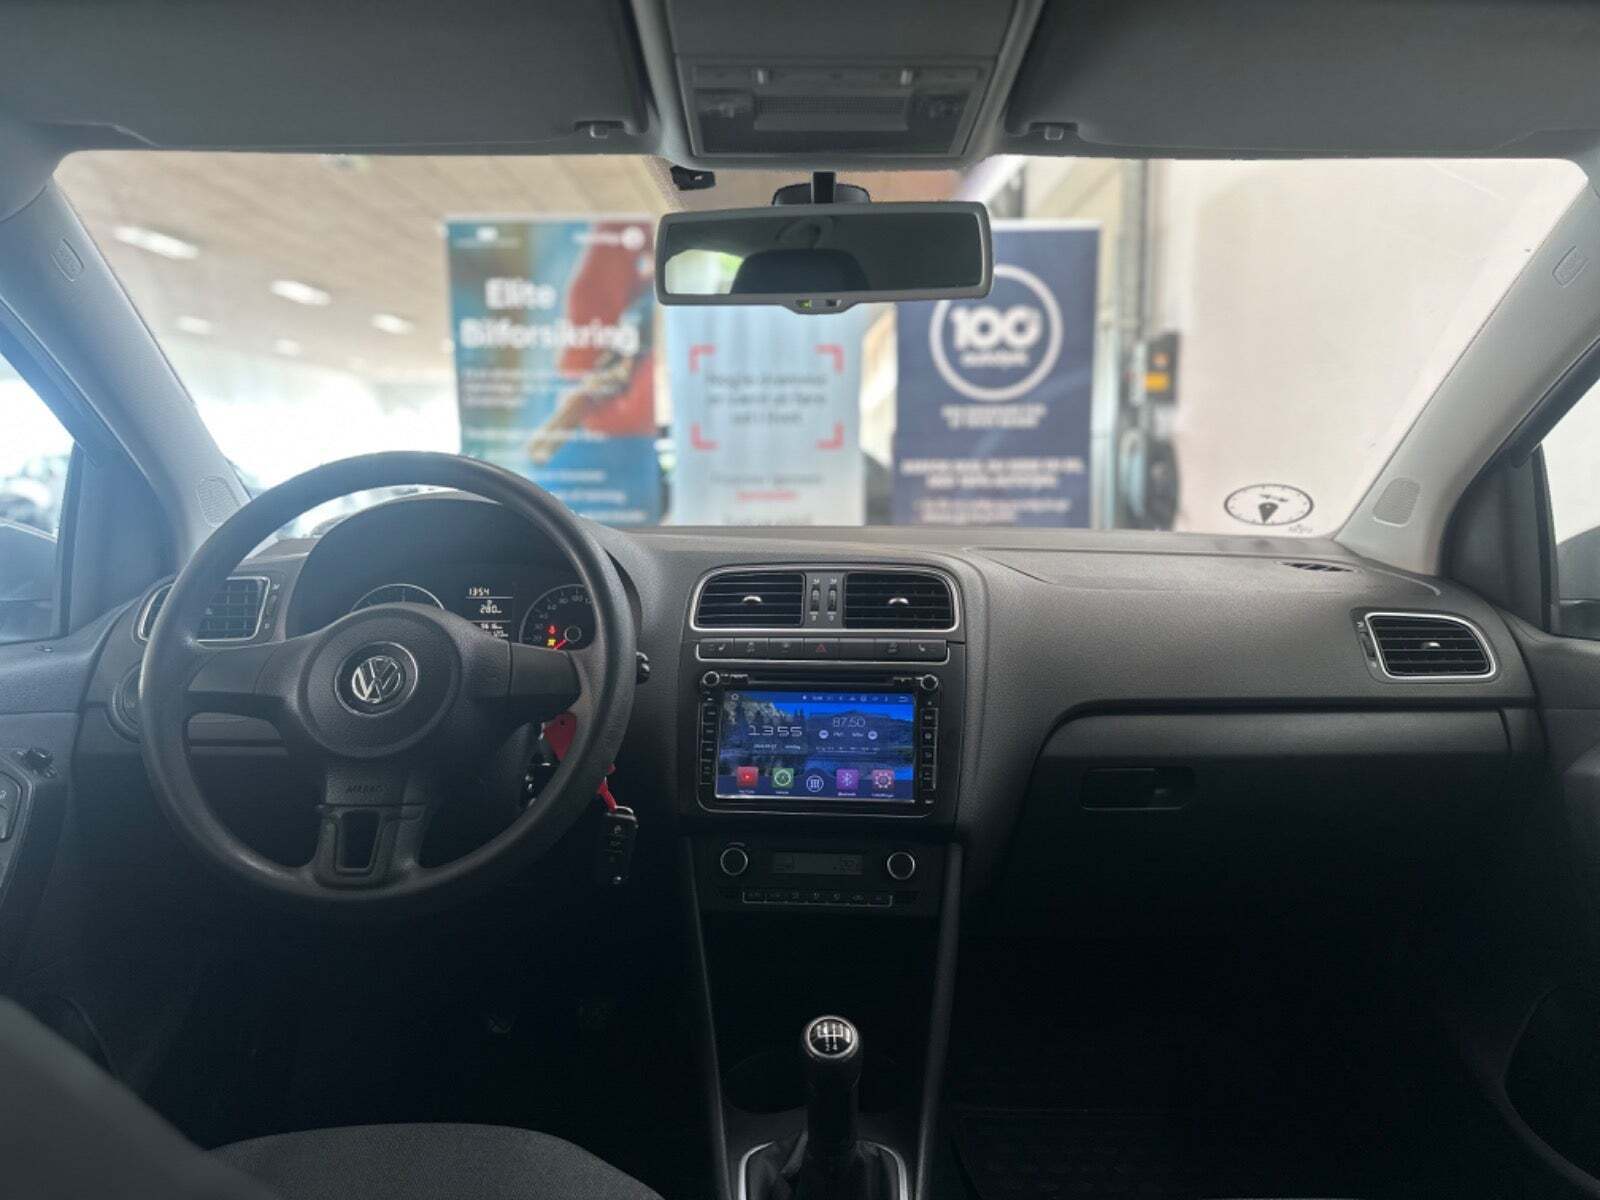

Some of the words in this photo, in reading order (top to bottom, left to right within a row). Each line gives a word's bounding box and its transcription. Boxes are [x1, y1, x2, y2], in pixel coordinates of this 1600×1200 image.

[485, 278, 557, 310] Elite
[460, 317, 640, 357] Bilforsikring
[952, 305, 1042, 350] 100
